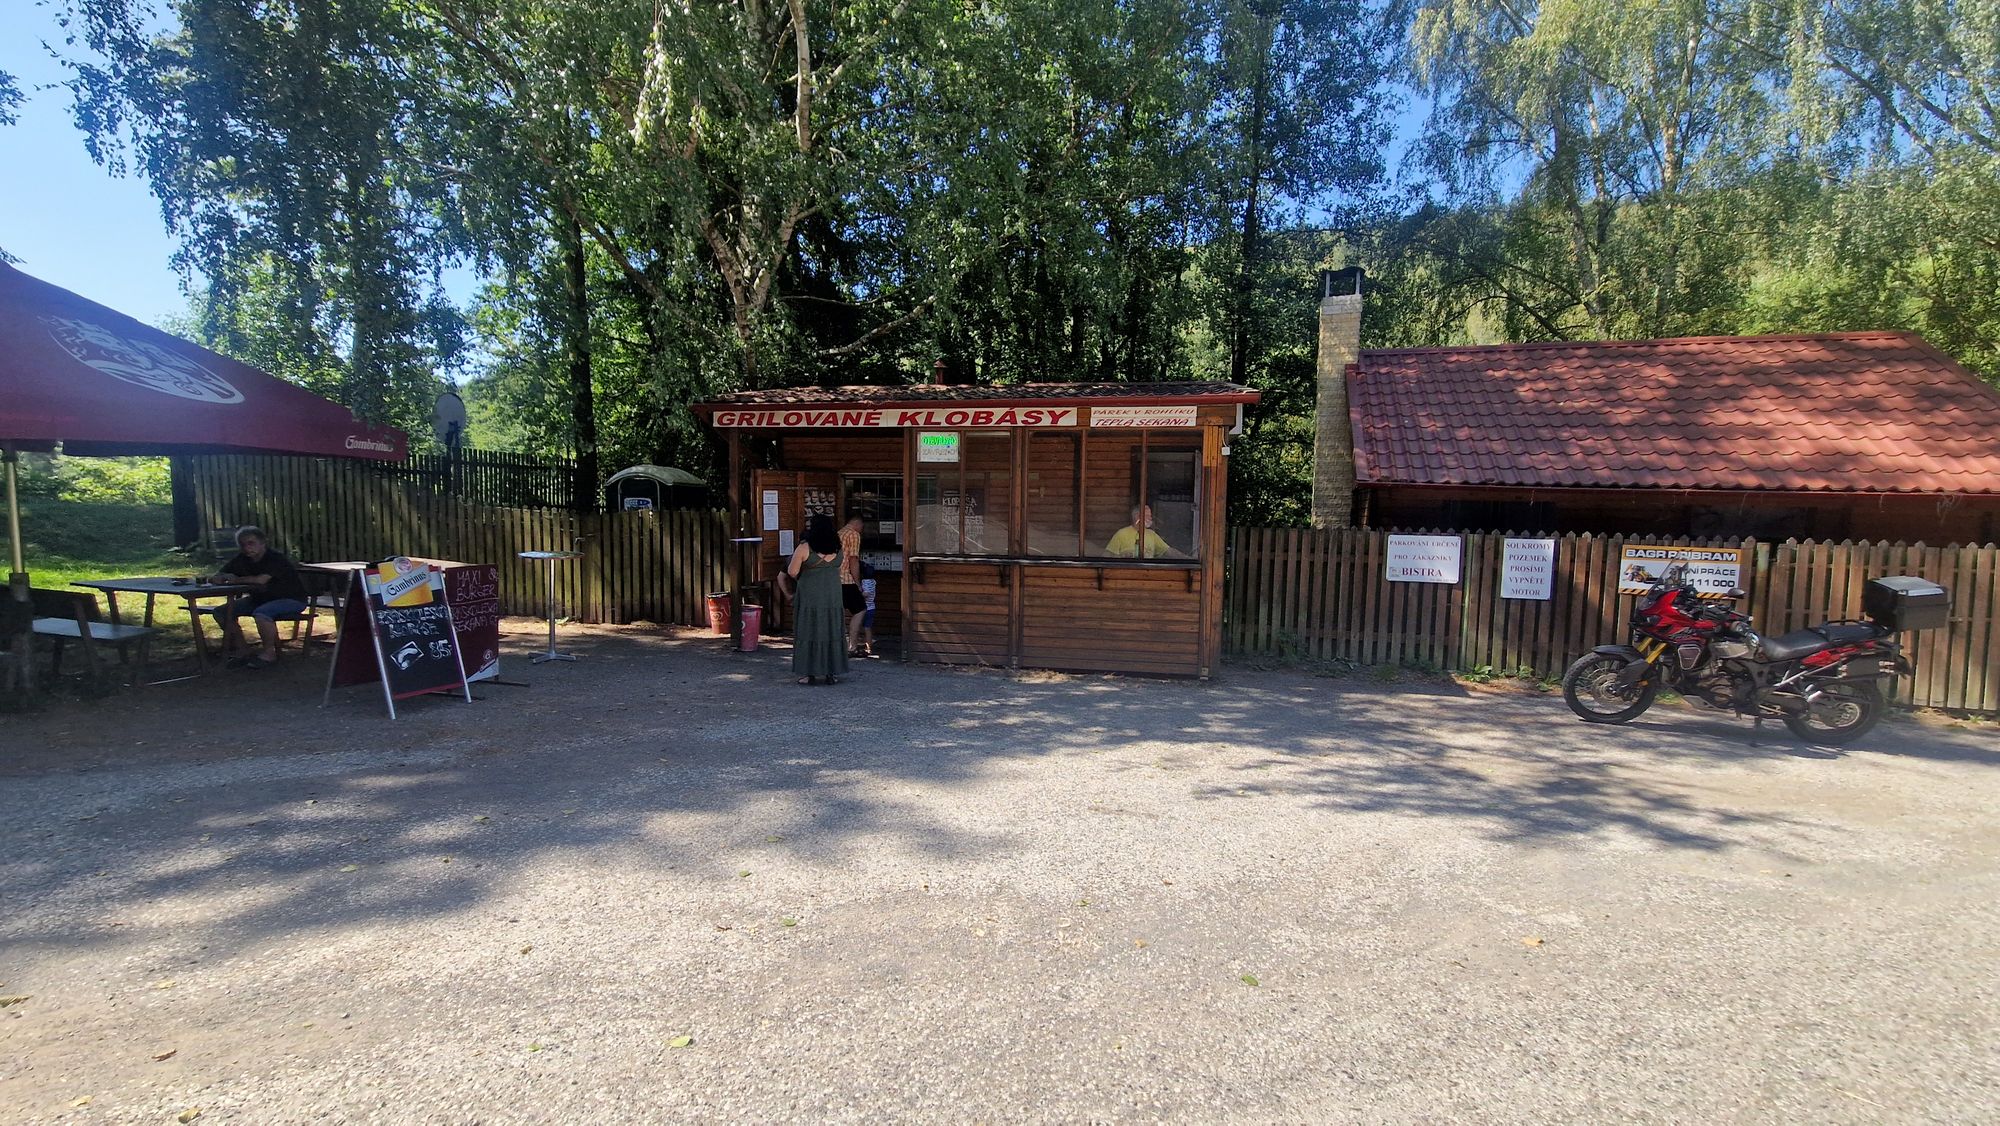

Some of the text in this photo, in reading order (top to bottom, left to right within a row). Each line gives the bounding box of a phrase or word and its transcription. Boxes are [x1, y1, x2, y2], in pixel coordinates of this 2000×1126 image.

[717, 408, 1072, 426] GRILOVANÉ KLOBÁSY
[1626, 549, 1666, 558] BAGR
[1402, 567, 1443, 577] BISTRA
[1701, 567, 1736, 576] PRÁCE
[387, 572, 427, 596] Gambrinus
[1511, 588, 1540, 596] MOTOR
